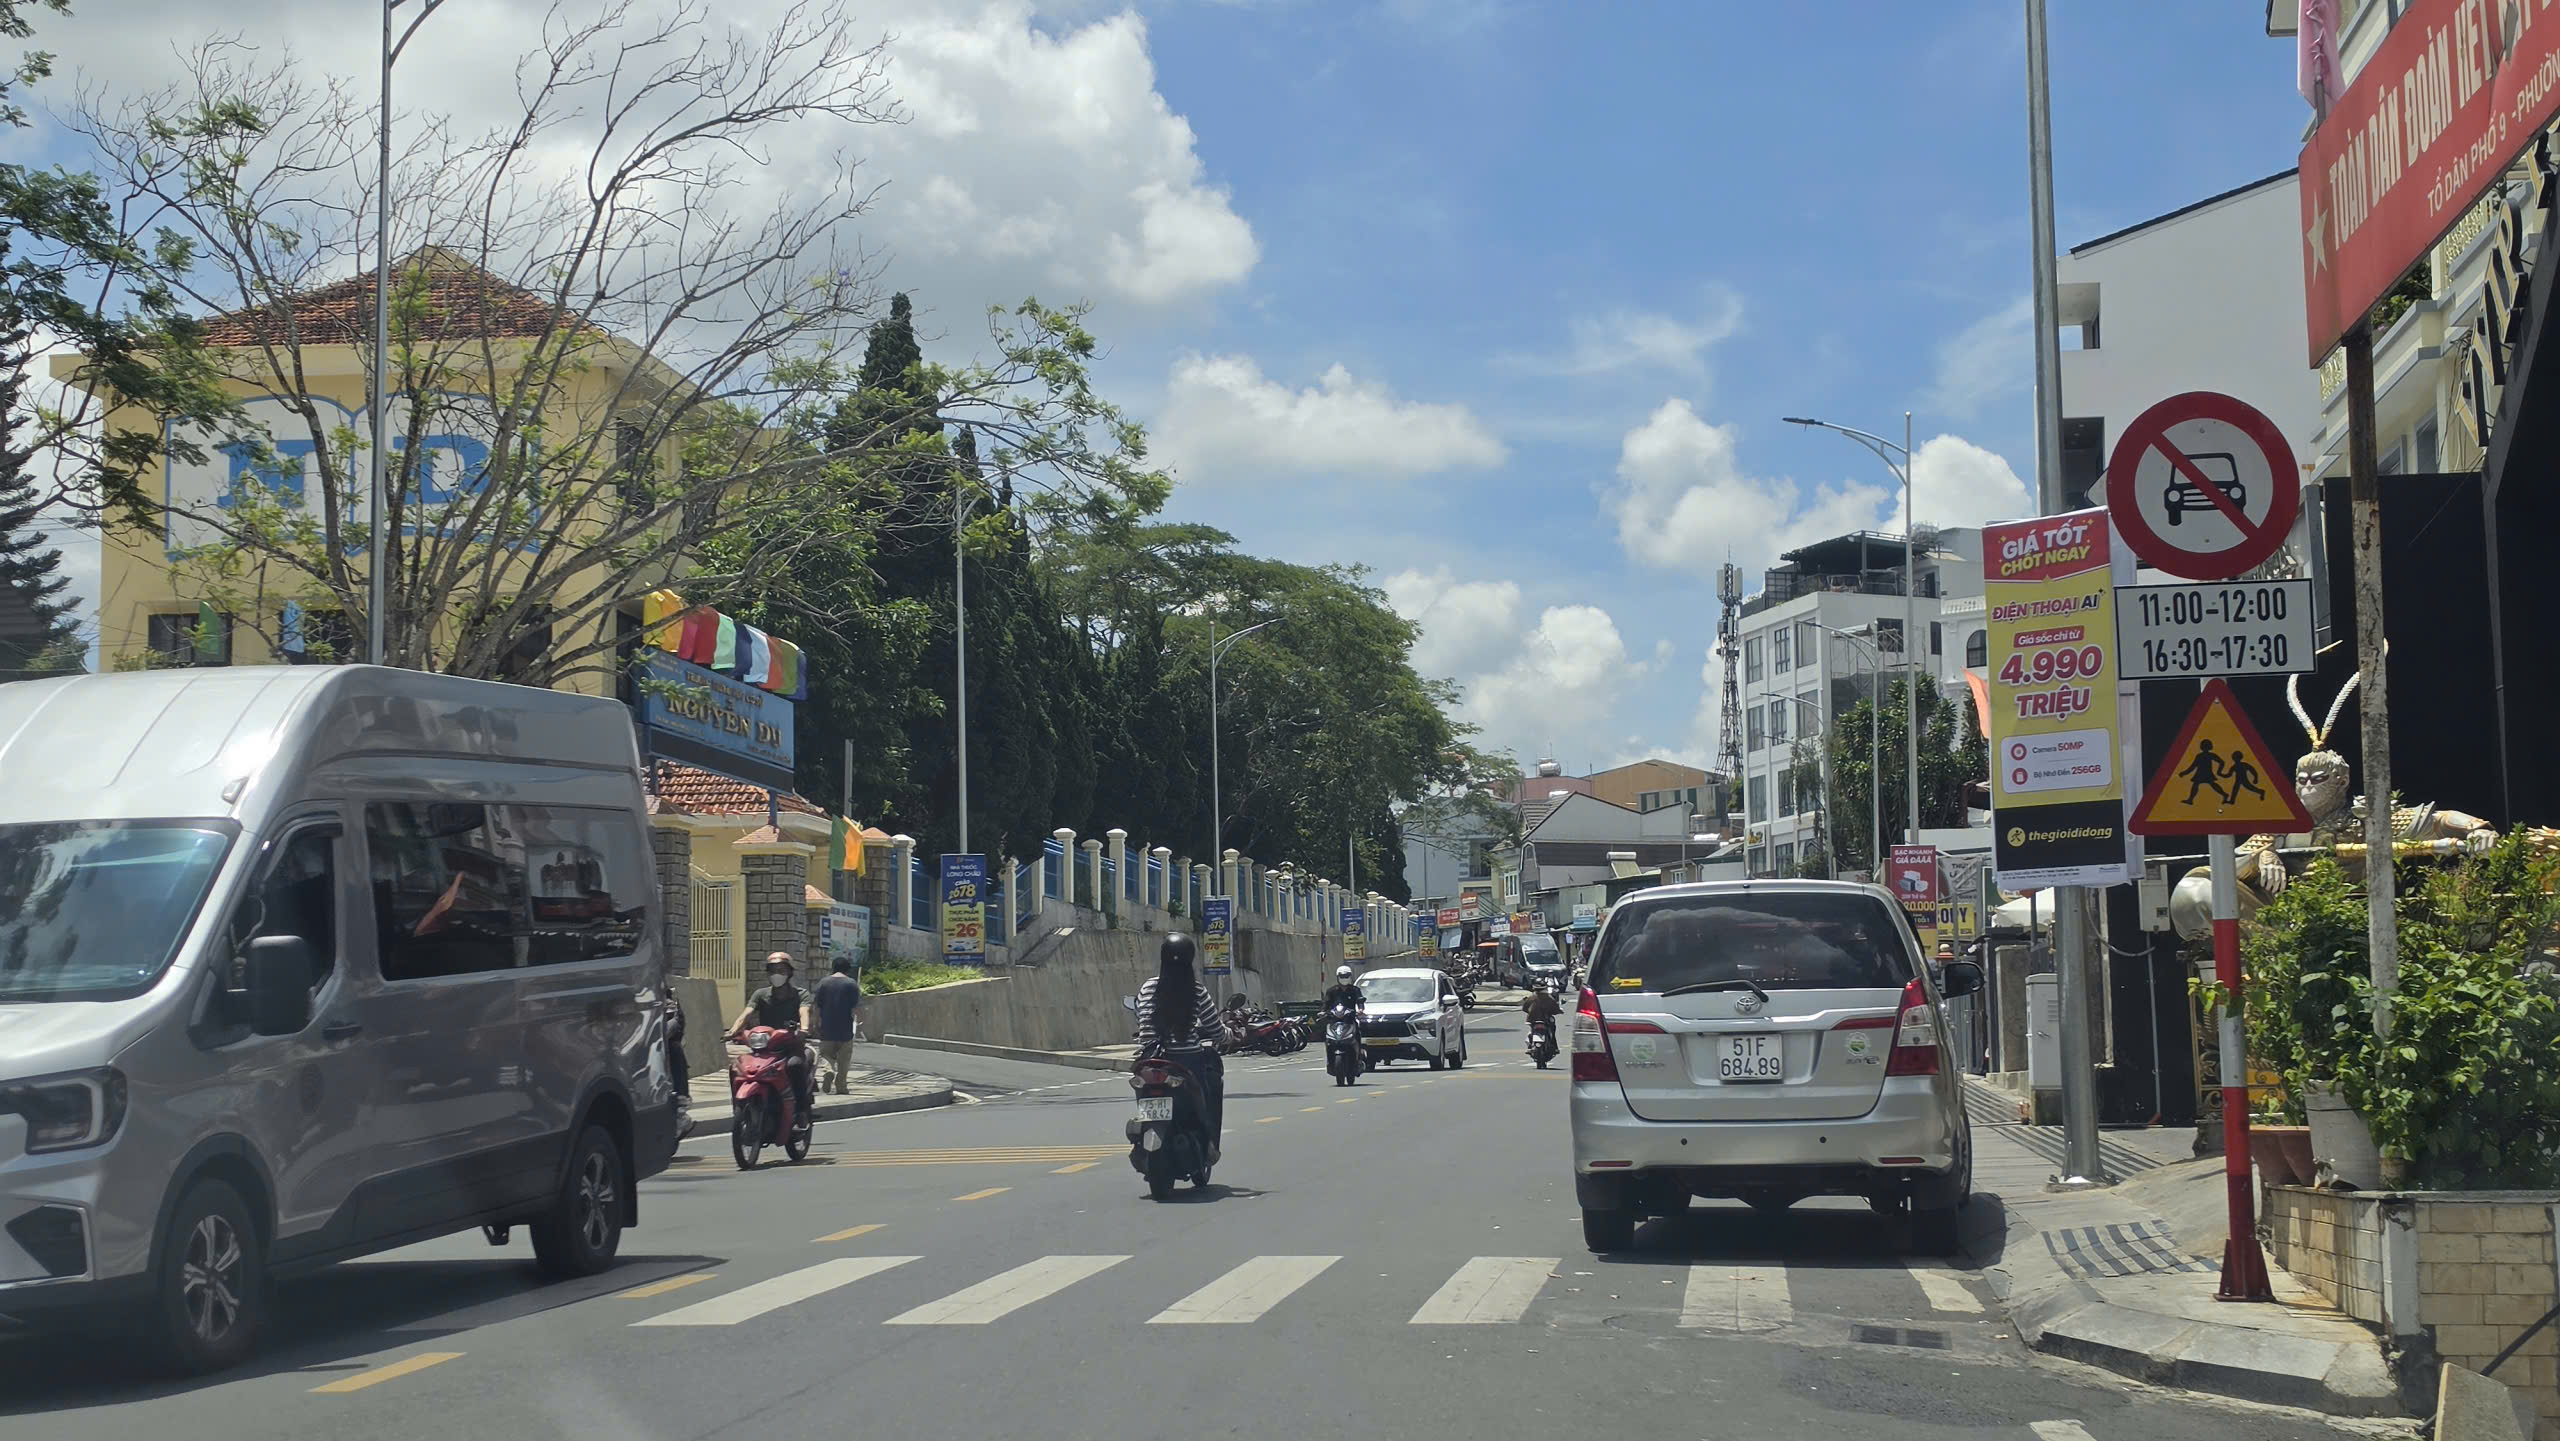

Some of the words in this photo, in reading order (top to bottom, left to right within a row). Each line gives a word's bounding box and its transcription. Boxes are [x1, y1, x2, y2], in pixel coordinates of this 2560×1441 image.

[2329, 128, 2368, 251] TOÀN
[2368, 84, 2402, 208] DÂN
[2404, 24, 2453, 168] ĐOÀN
[2427, 166, 2443, 217] TỔ
[2445, 156, 2469, 202] DÂN
[2470, 110, 2497, 173] PHỐ
[2499, 112, 2507, 142] 9
[2002, 529, 2040, 560] GIÁ
[2043, 519, 2088, 547] TỐT
[2000, 551, 2043, 577] CHỐT
[2045, 545, 2091, 565] NGAY
[1992, 601, 2028, 623] ĐIỆN
[2031, 597, 2079, 616] THOẠI
[2081, 594, 2099, 611] AI
[2138, 587, 2287, 627] 11:00-12:00
[2018, 634, 2034, 645] Giá
[2035, 631, 2052, 644] sốc
[2142, 634, 2288, 673] 16:30-17:30
[2000, 645, 2103, 685] 4.990
[2016, 684, 2091, 720] TRIỆU
[2032, 746, 2057, 754] Camera
[2058, 741, 2084, 751] 50MP
[2071, 764, 2102, 775] 256GB
[2028, 827, 2113, 843] thegioididong
[1732, 1037, 1767, 1057] 51F
[1721, 1057, 1781, 1077] 684.89
